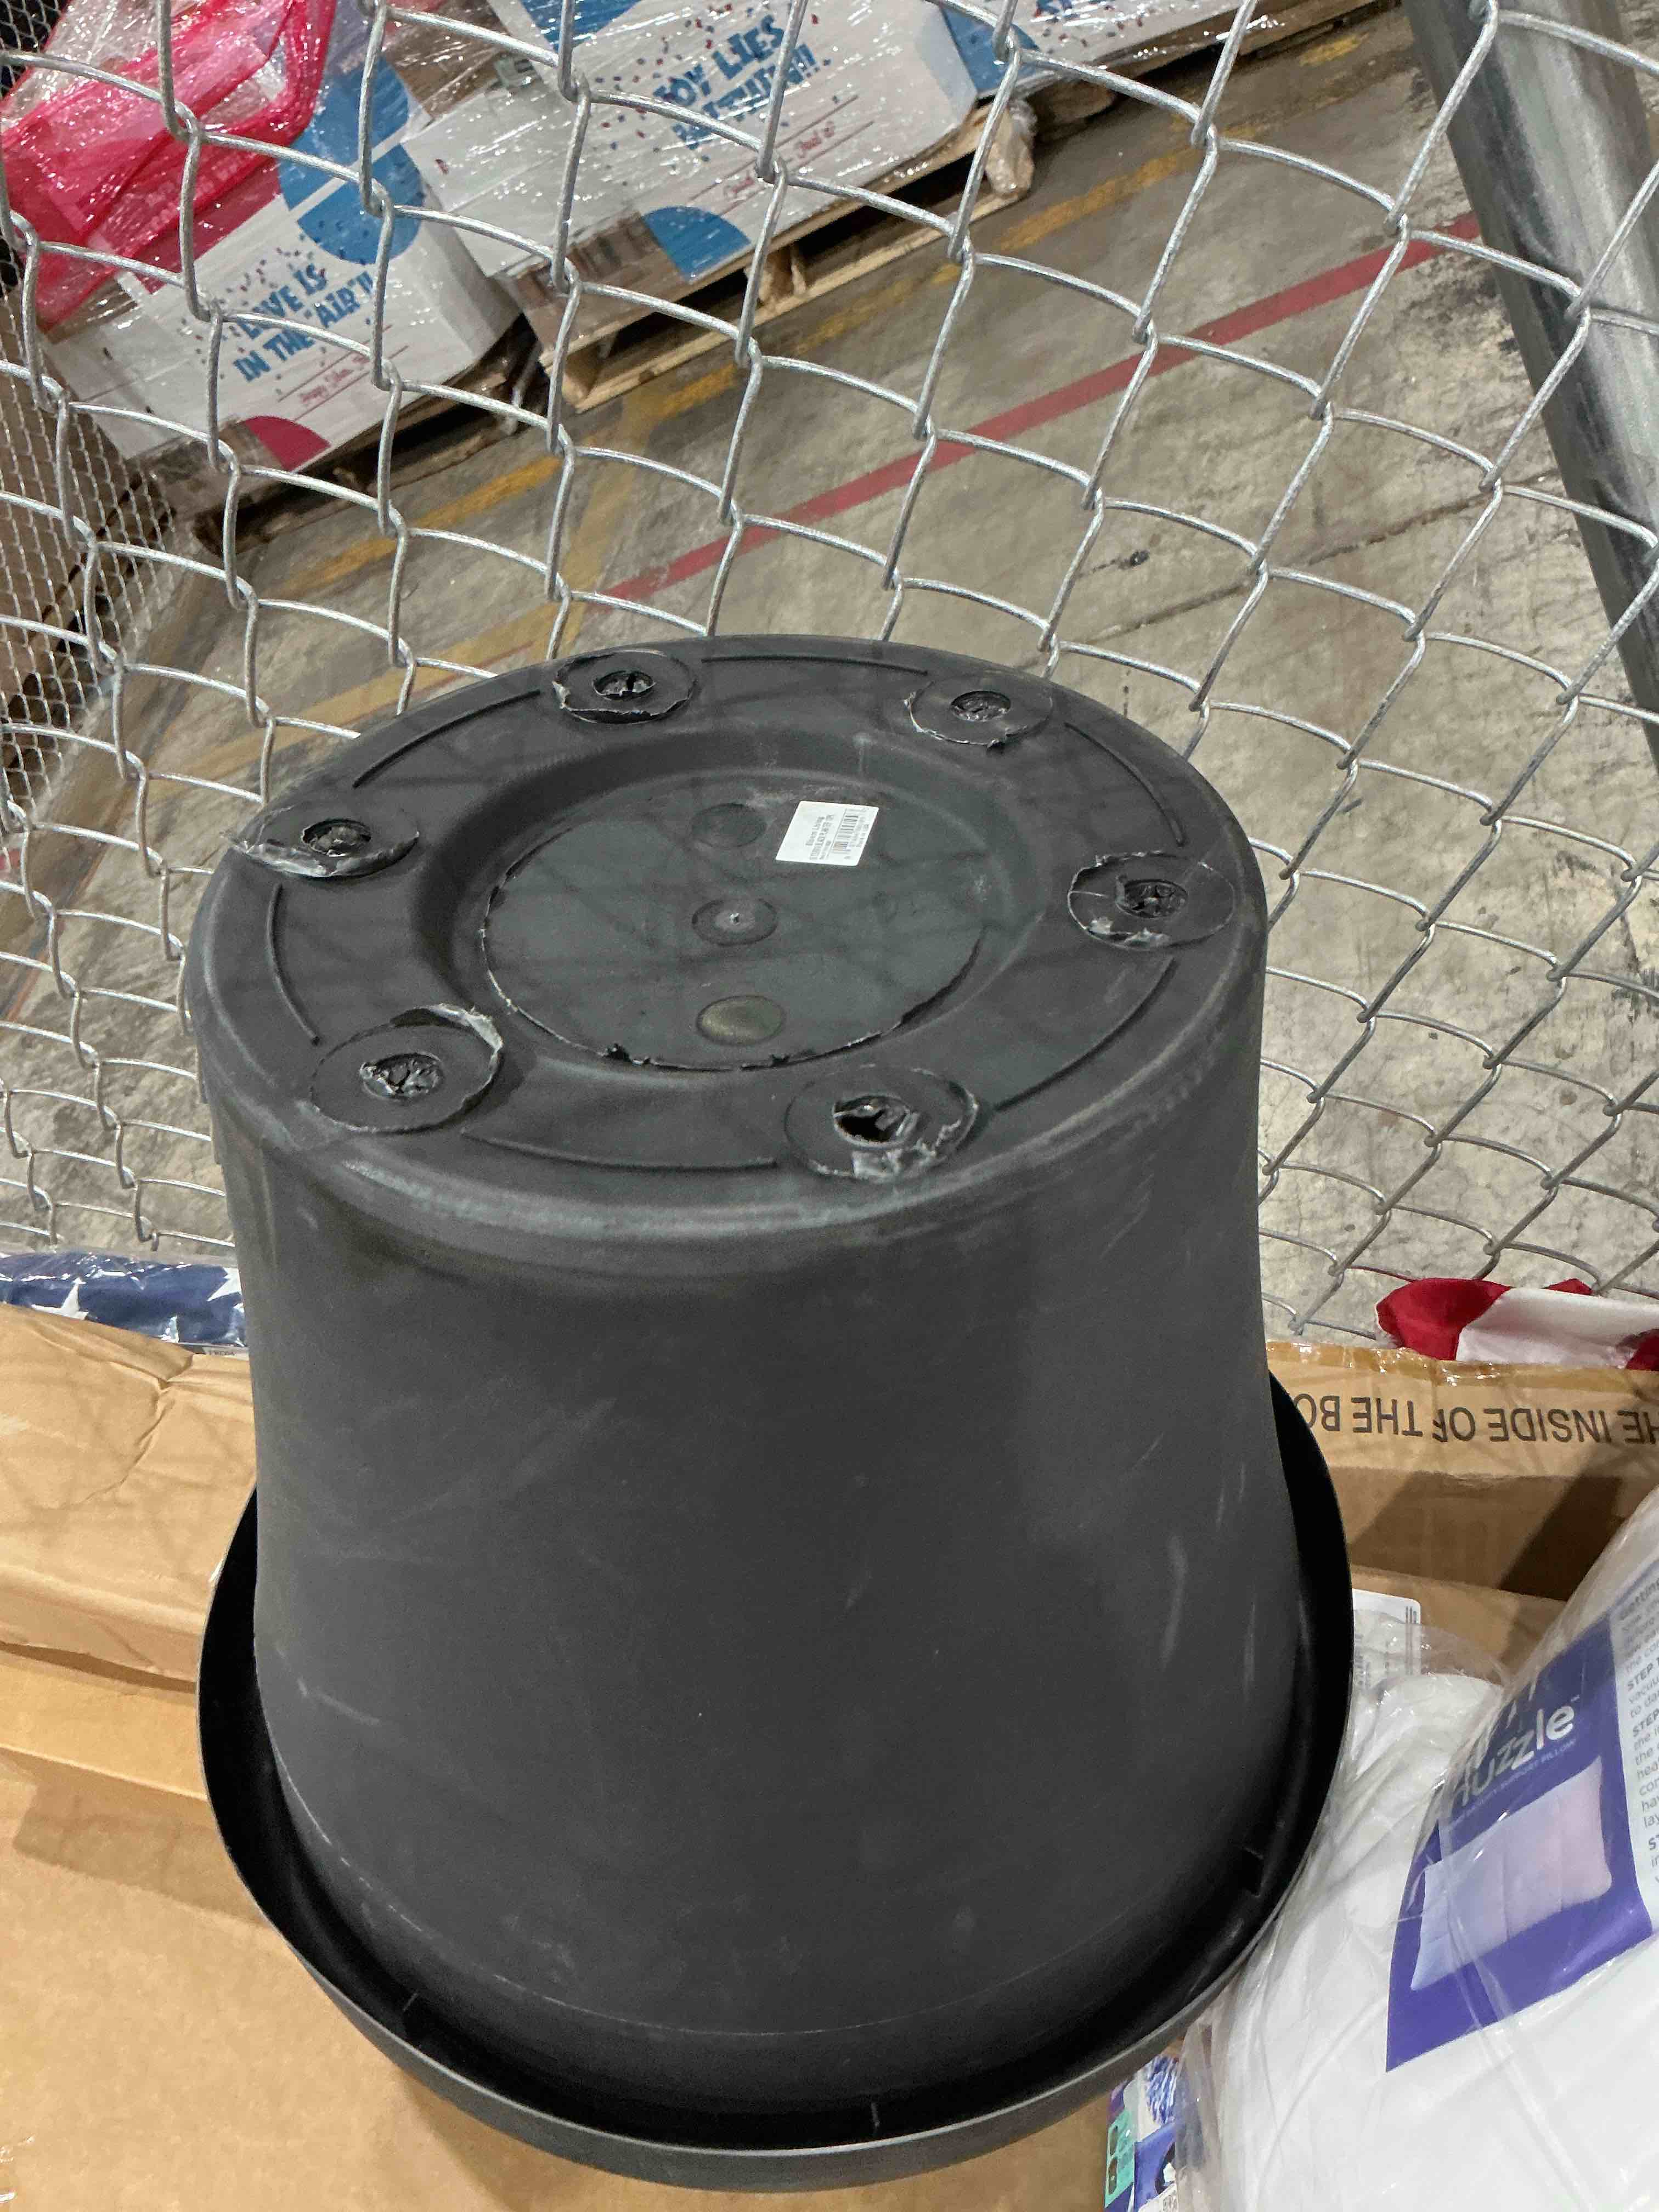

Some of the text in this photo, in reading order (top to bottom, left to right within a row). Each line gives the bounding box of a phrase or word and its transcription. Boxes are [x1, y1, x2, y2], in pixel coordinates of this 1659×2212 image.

[712, 15, 785, 80] LIES
[292, 264, 326, 295] IS
[233, 350, 271, 382] IN
[263, 328, 316, 361] THE
[1351, 1396, 1423, 1437] THE
[1432, 1407, 1476, 1443] OF
[1483, 1408, 1611, 1444] INSIDE
[1627, 1663, 1654, 1692] STEP
[1632, 1708, 1659, 1738] STEP
